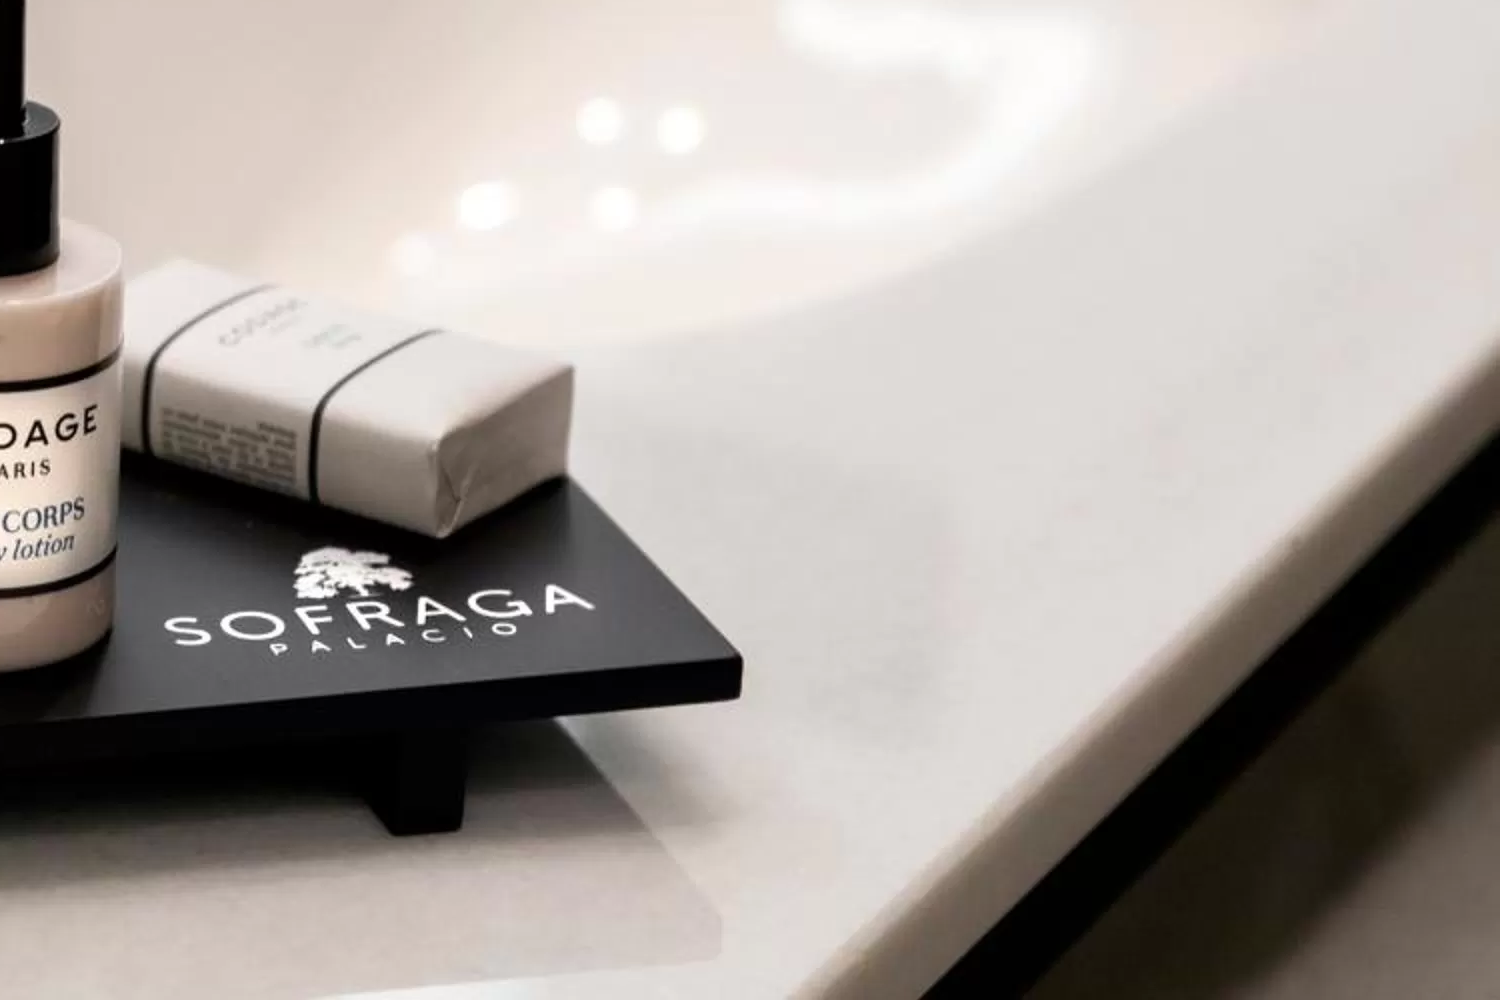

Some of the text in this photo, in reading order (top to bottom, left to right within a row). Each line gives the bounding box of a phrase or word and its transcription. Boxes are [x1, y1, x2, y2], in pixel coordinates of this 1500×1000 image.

[2, 497, 85, 533] CORPS
[12, 534, 75, 560] lotion
[162, 584, 596, 647] SOFRAGA
[269, 623, 518, 656] PALACIO
